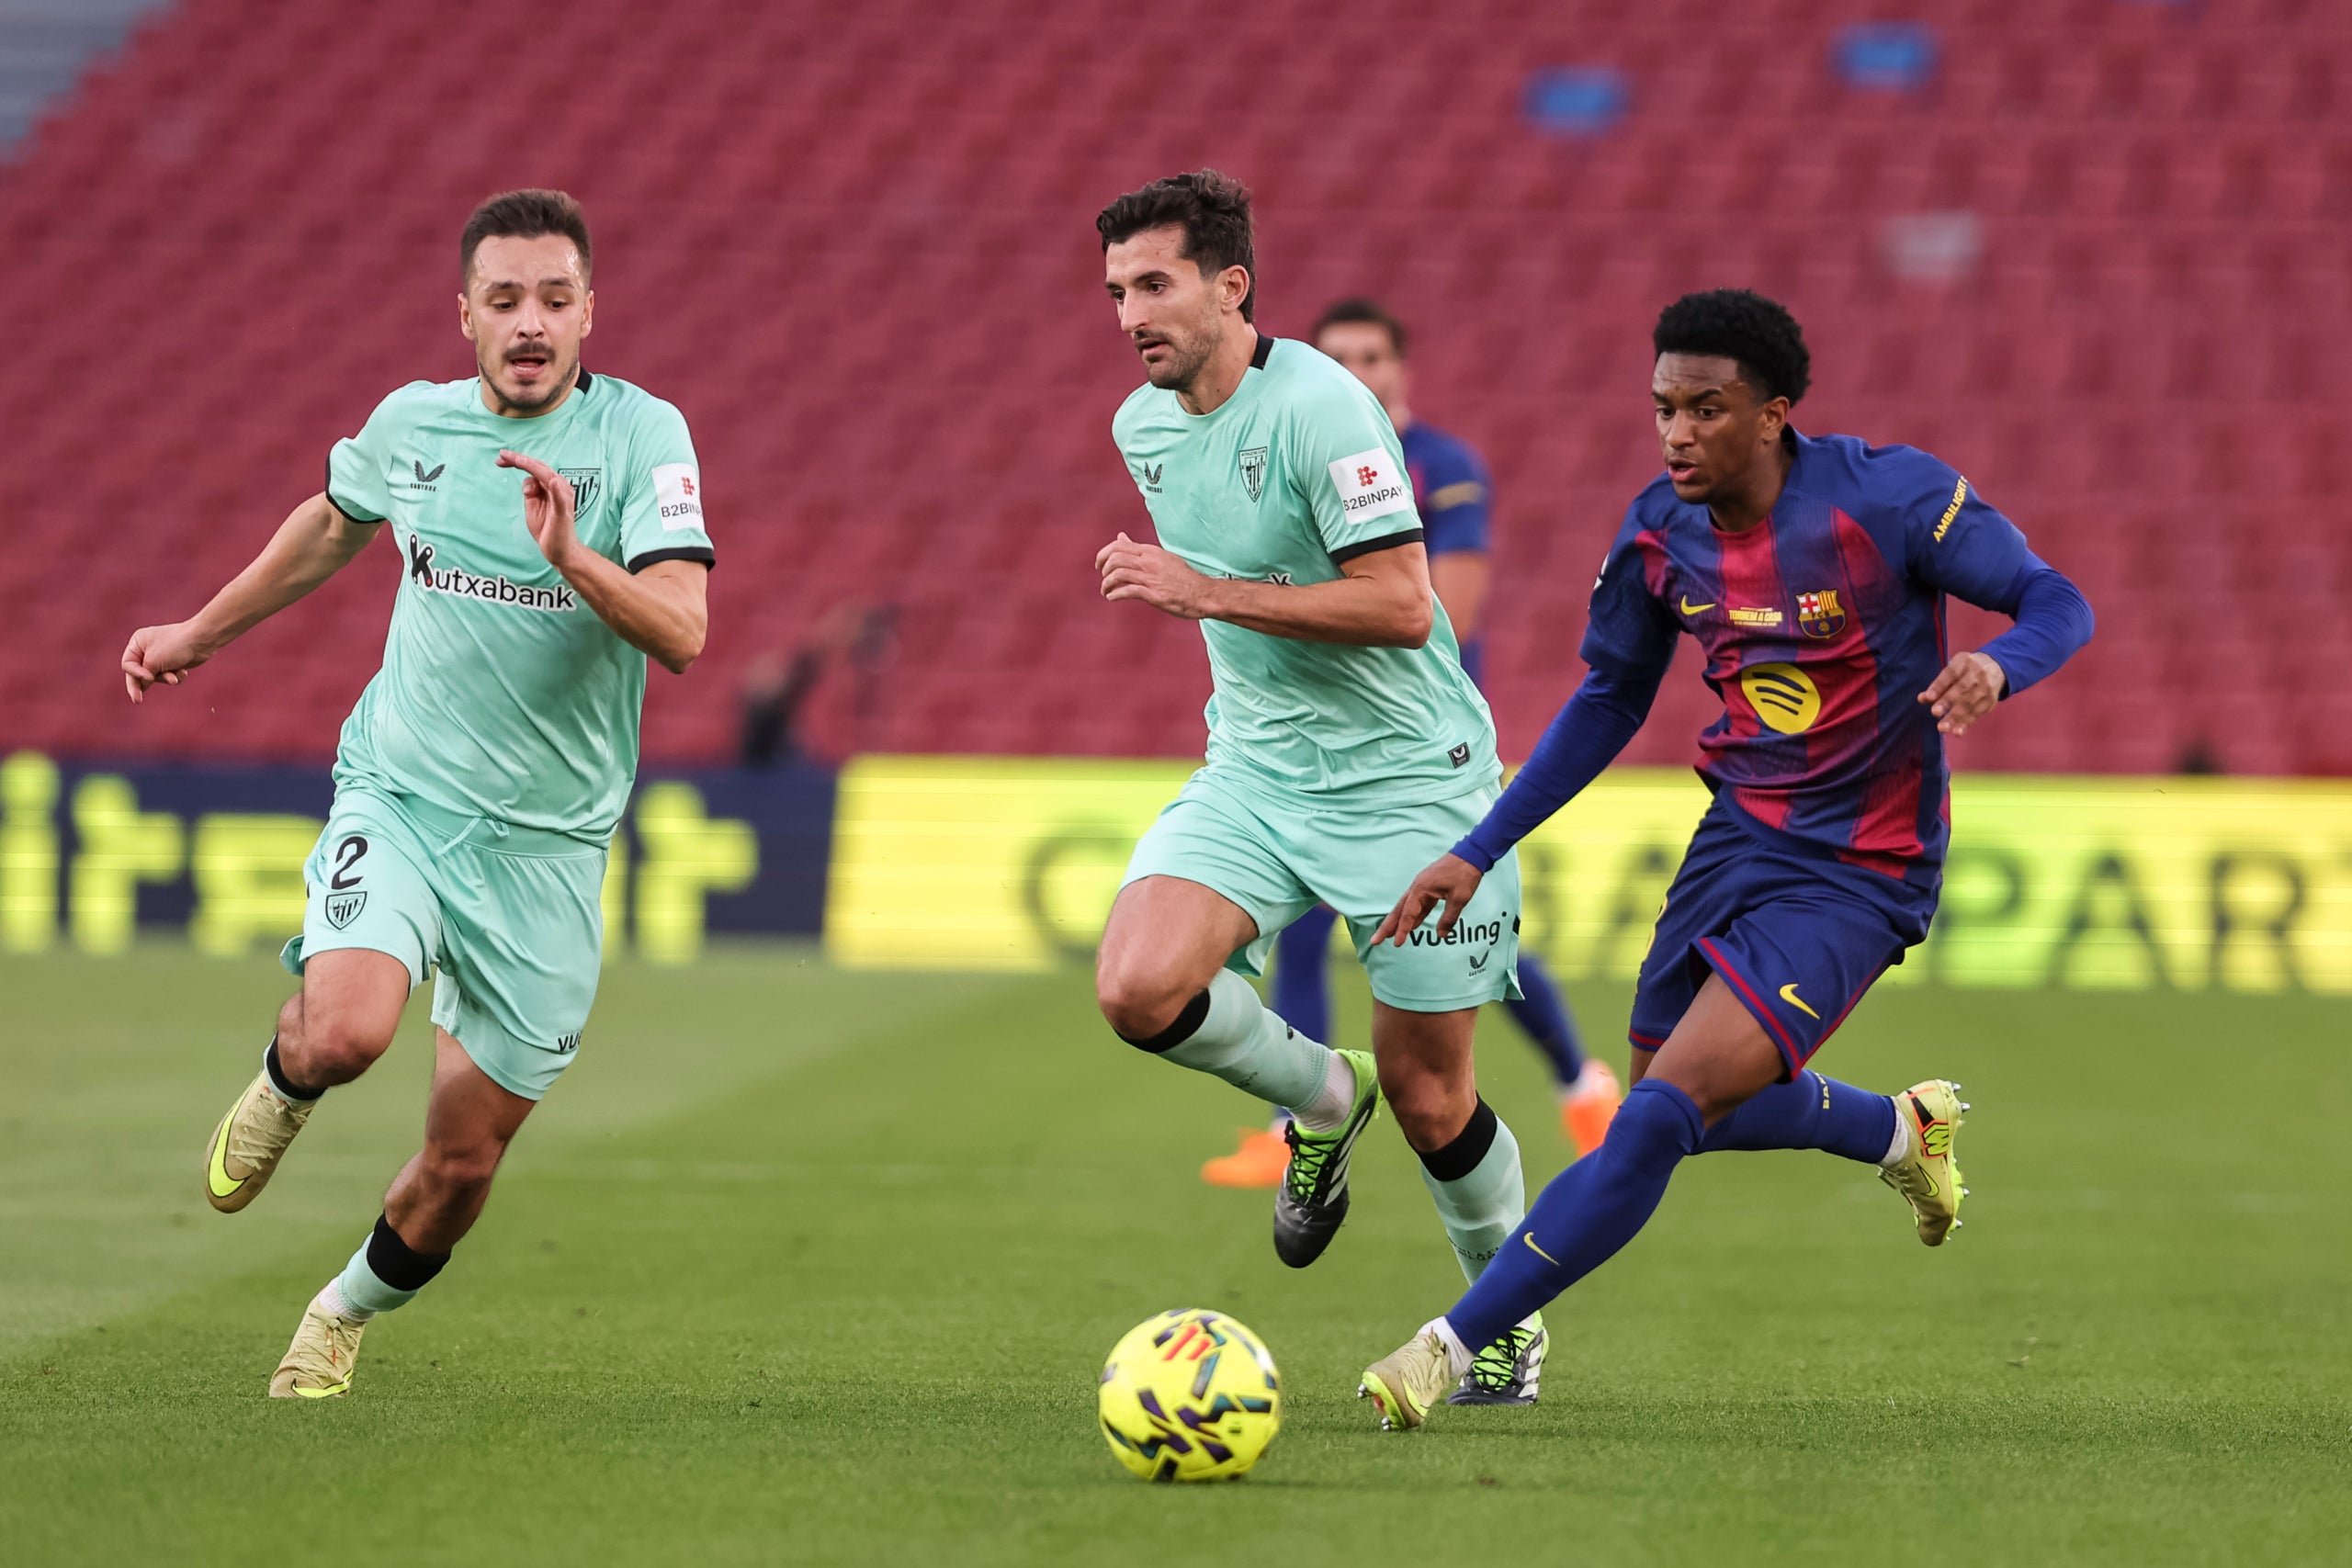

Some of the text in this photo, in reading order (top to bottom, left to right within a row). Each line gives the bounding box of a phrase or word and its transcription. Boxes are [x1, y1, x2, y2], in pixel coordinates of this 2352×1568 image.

[410, 534, 574, 609] Kutxabank
[331, 836, 368, 890] 2
[1409, 916, 1502, 947] vueling
